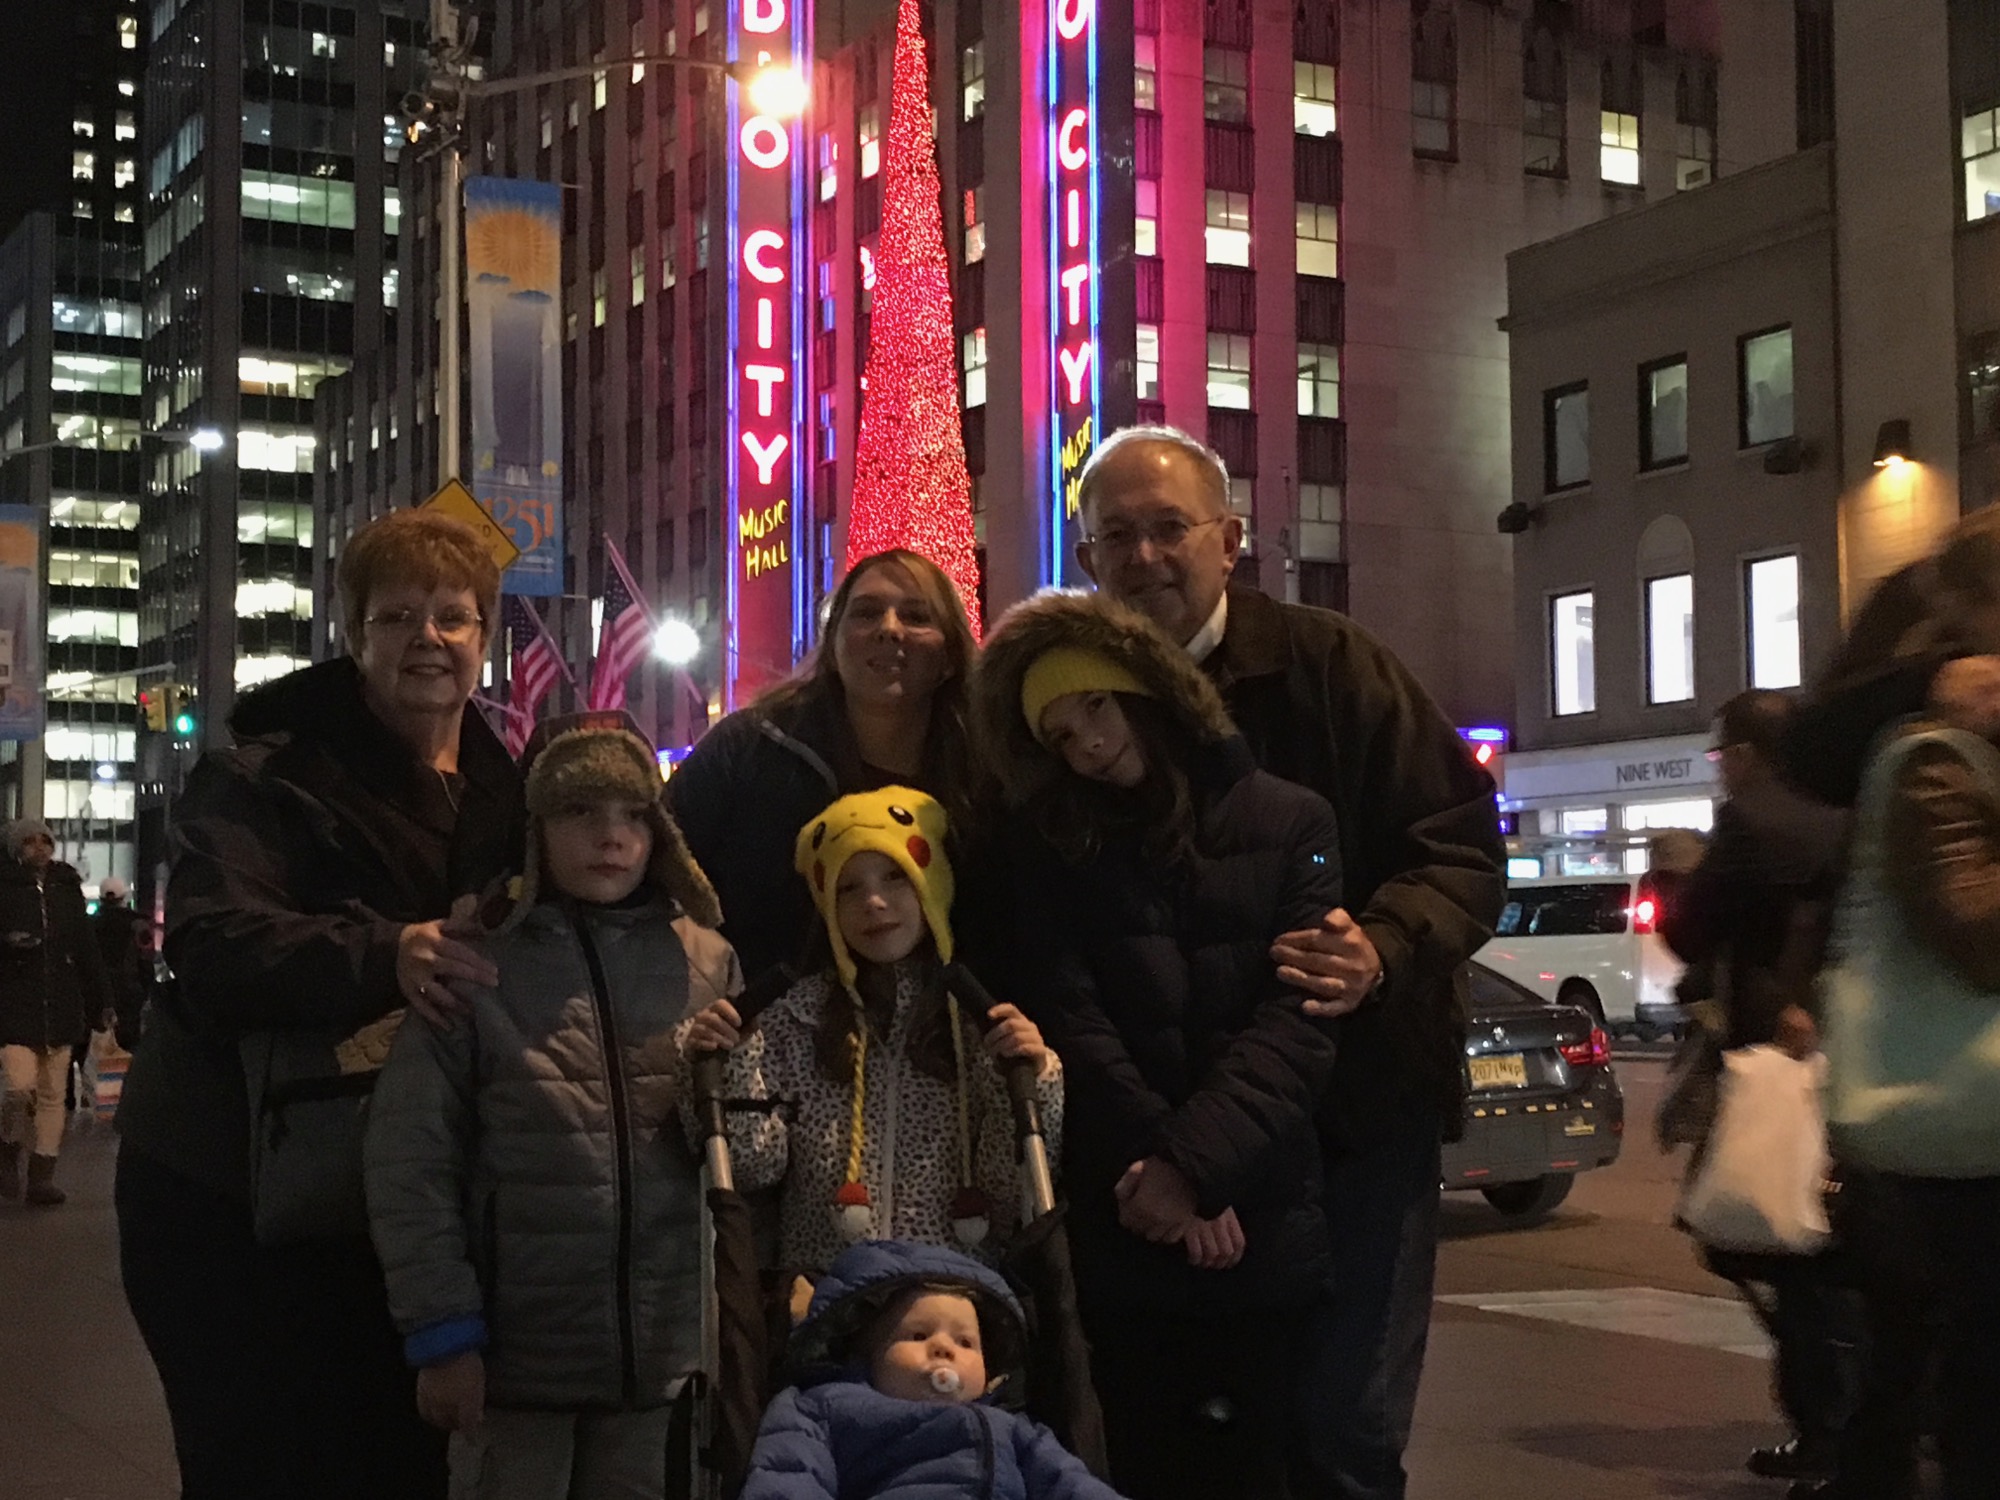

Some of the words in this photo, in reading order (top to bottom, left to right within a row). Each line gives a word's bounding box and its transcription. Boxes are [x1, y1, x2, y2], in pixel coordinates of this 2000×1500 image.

[740, 0, 789, 168] DO
[742, 230, 788, 485] CITY
[1059, 109, 1092, 404] CITY
[1616, 762, 1650, 783] NINE
[1654, 758, 1692, 778] WEST
